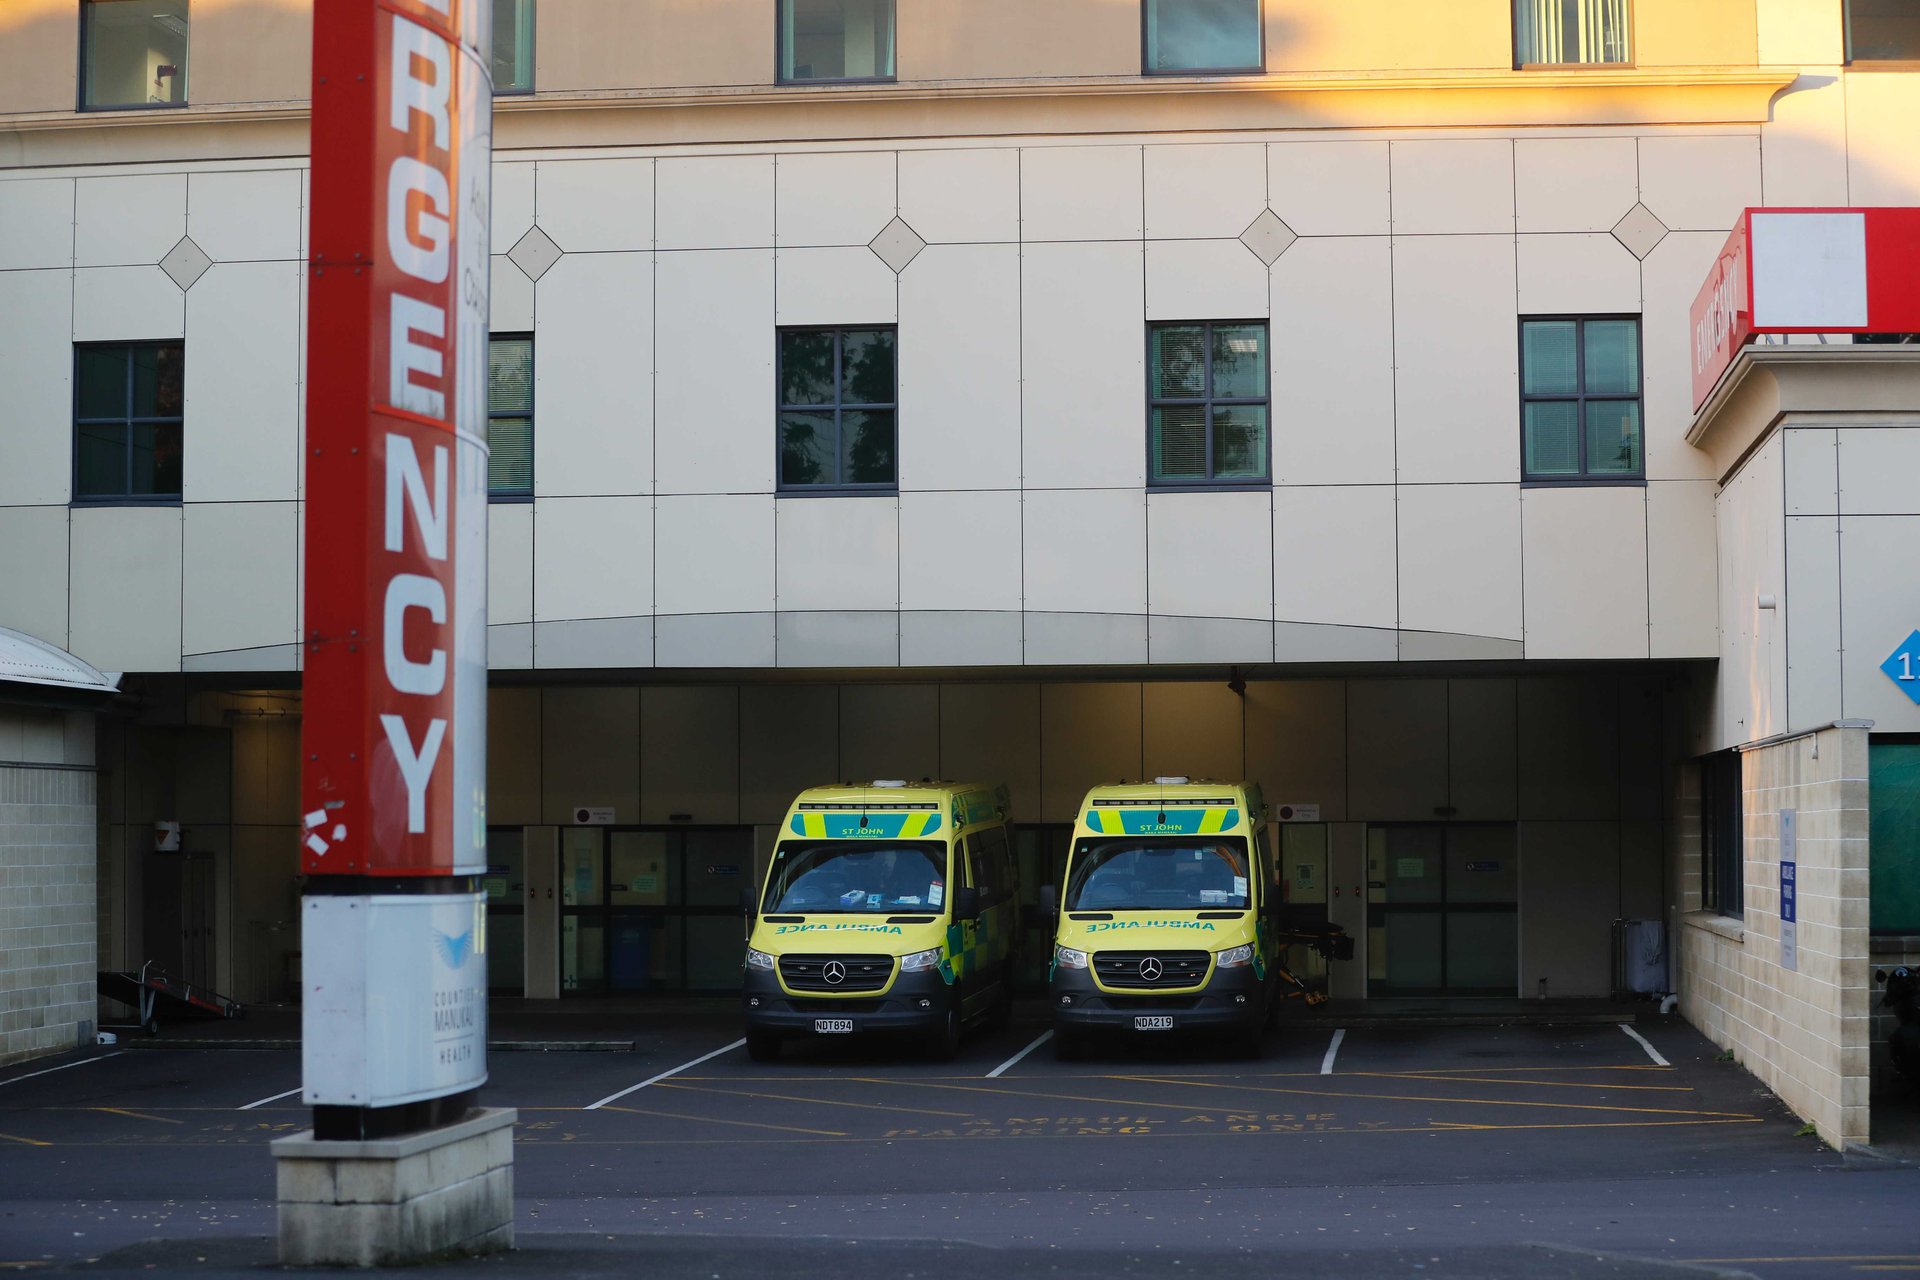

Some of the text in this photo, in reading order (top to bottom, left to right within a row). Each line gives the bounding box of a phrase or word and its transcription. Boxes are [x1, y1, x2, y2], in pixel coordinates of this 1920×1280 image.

[380, 0, 452, 833] RGENCY
[1898, 652, 1920, 680] 1
[816, 1020, 851, 1030] NDT894
[1135, 1017, 1172, 1027] NDA219
[440, 1045, 471, 1065] HEALTH
[961, 1112, 1338, 1126] AMBULANCE
[881, 1120, 1390, 1138] PARKING ONLY
